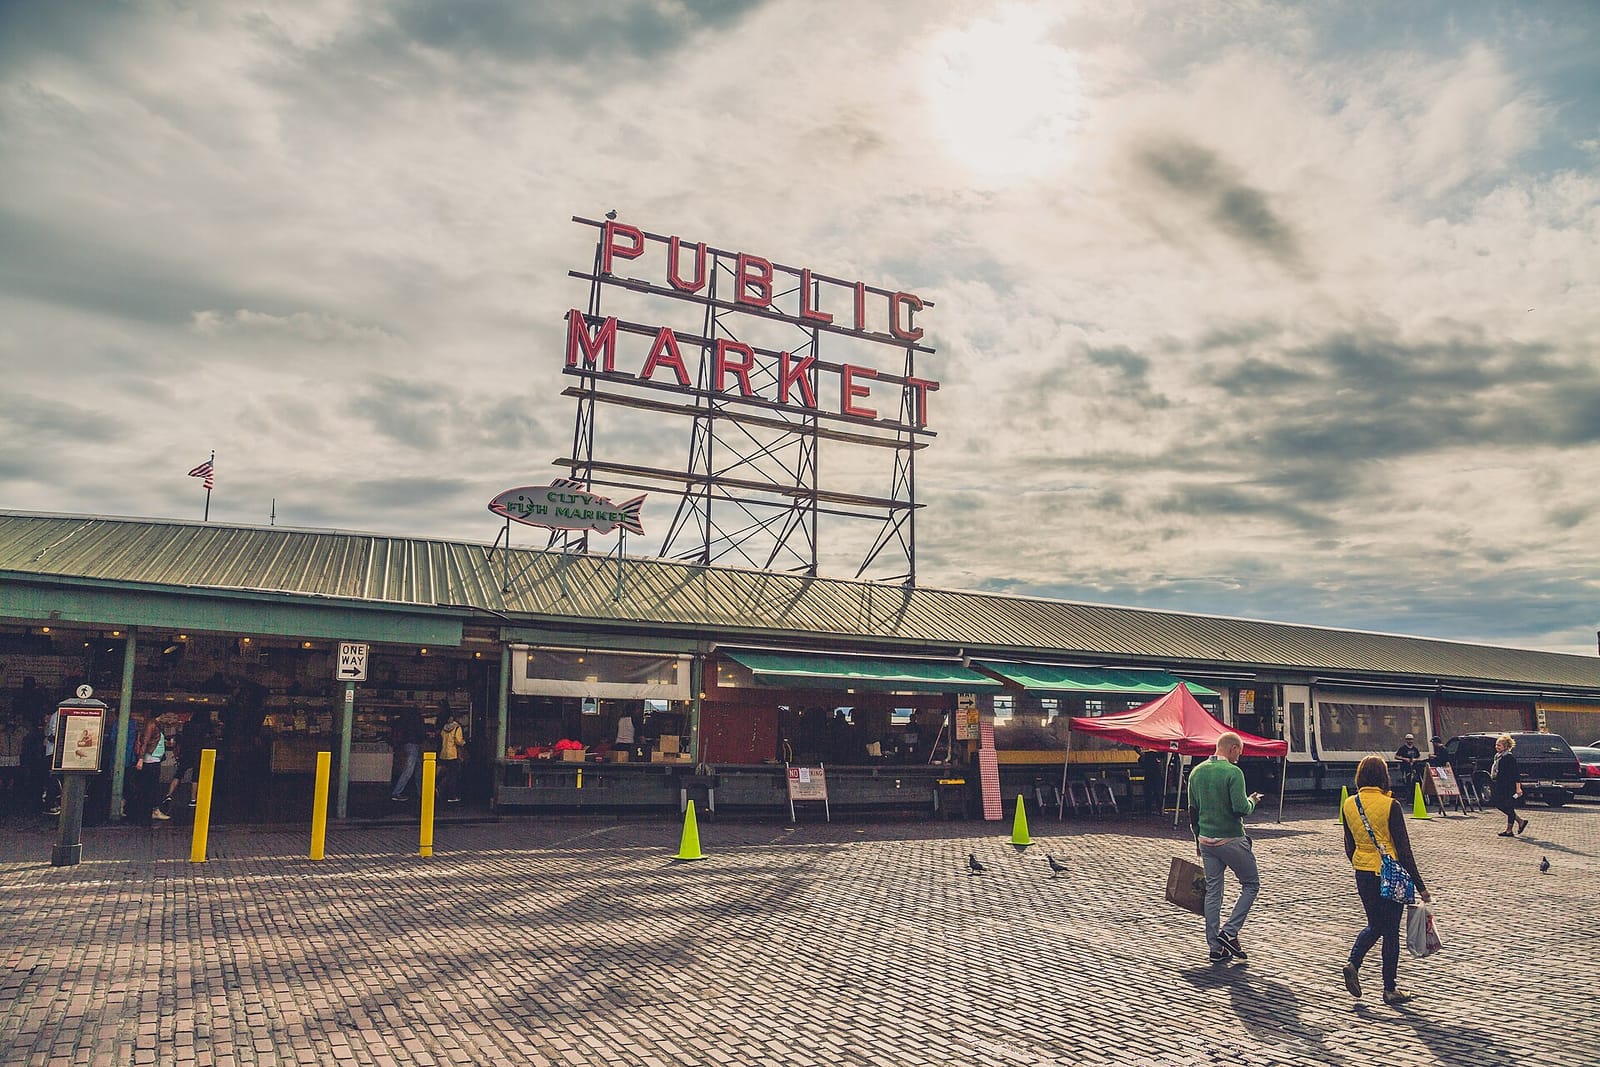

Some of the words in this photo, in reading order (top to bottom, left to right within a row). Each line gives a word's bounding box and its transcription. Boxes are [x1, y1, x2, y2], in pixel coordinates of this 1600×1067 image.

[603, 220, 924, 341] PUBLIC
[566, 308, 940, 428] MARKET
[547, 491, 593, 505] CITY
[507, 501, 548, 515] FISH
[555, 506, 628, 522] MARKET
[342, 645, 364, 655] ONE
[341, 655, 364, 665] WAY
[789, 769, 799, 778] NO
